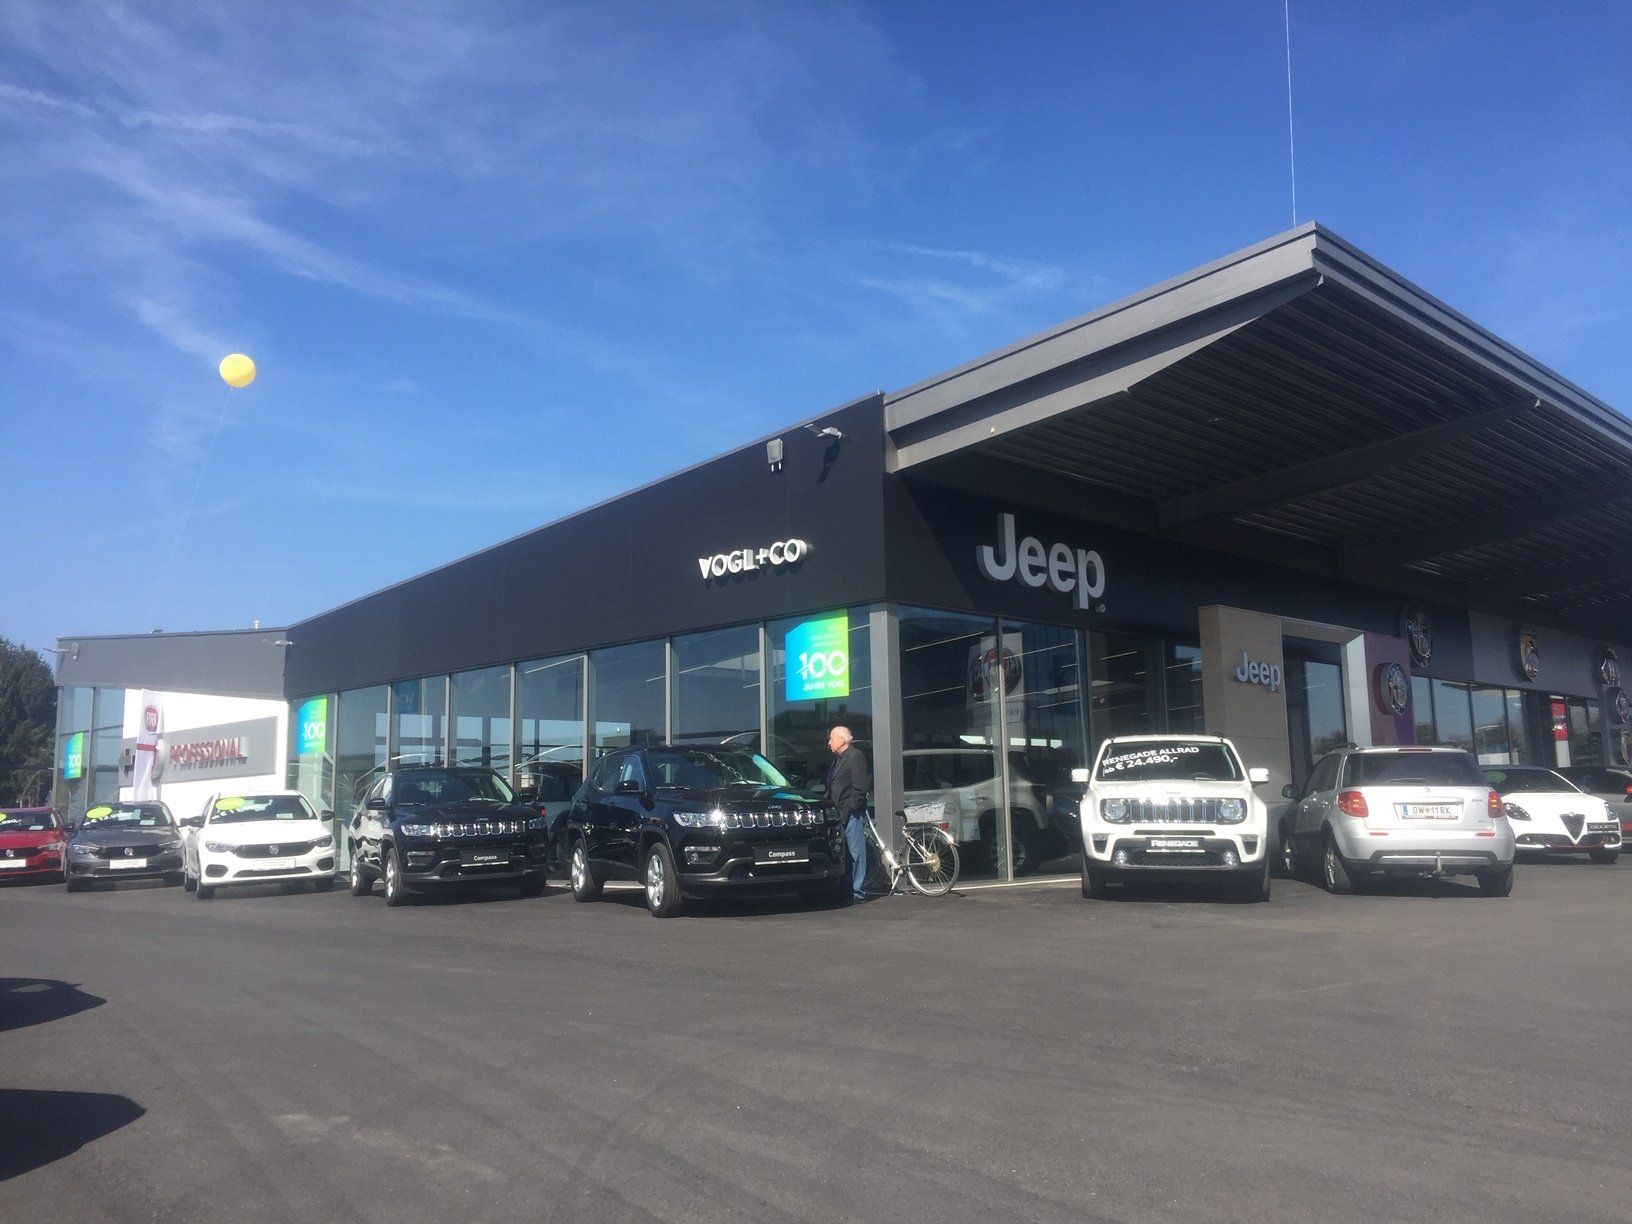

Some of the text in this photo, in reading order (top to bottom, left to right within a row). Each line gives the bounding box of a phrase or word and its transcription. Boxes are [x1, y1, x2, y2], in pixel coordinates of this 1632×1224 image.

[698, 538, 808, 579] VOGL+CO
[977, 512, 1105, 610] Jeep
[796, 649, 849, 680] 100
[1235, 651, 1281, 692] Jeep
[1102, 746, 1200, 767] RENEGADE ALLRAD
[1103, 766, 1115, 775] ab
[1115, 761, 1125, 771] €
[1151, 839, 1199, 848] RENEGADE
[473, 854, 498, 863] Compass
[768, 850, 796, 859] Compass
